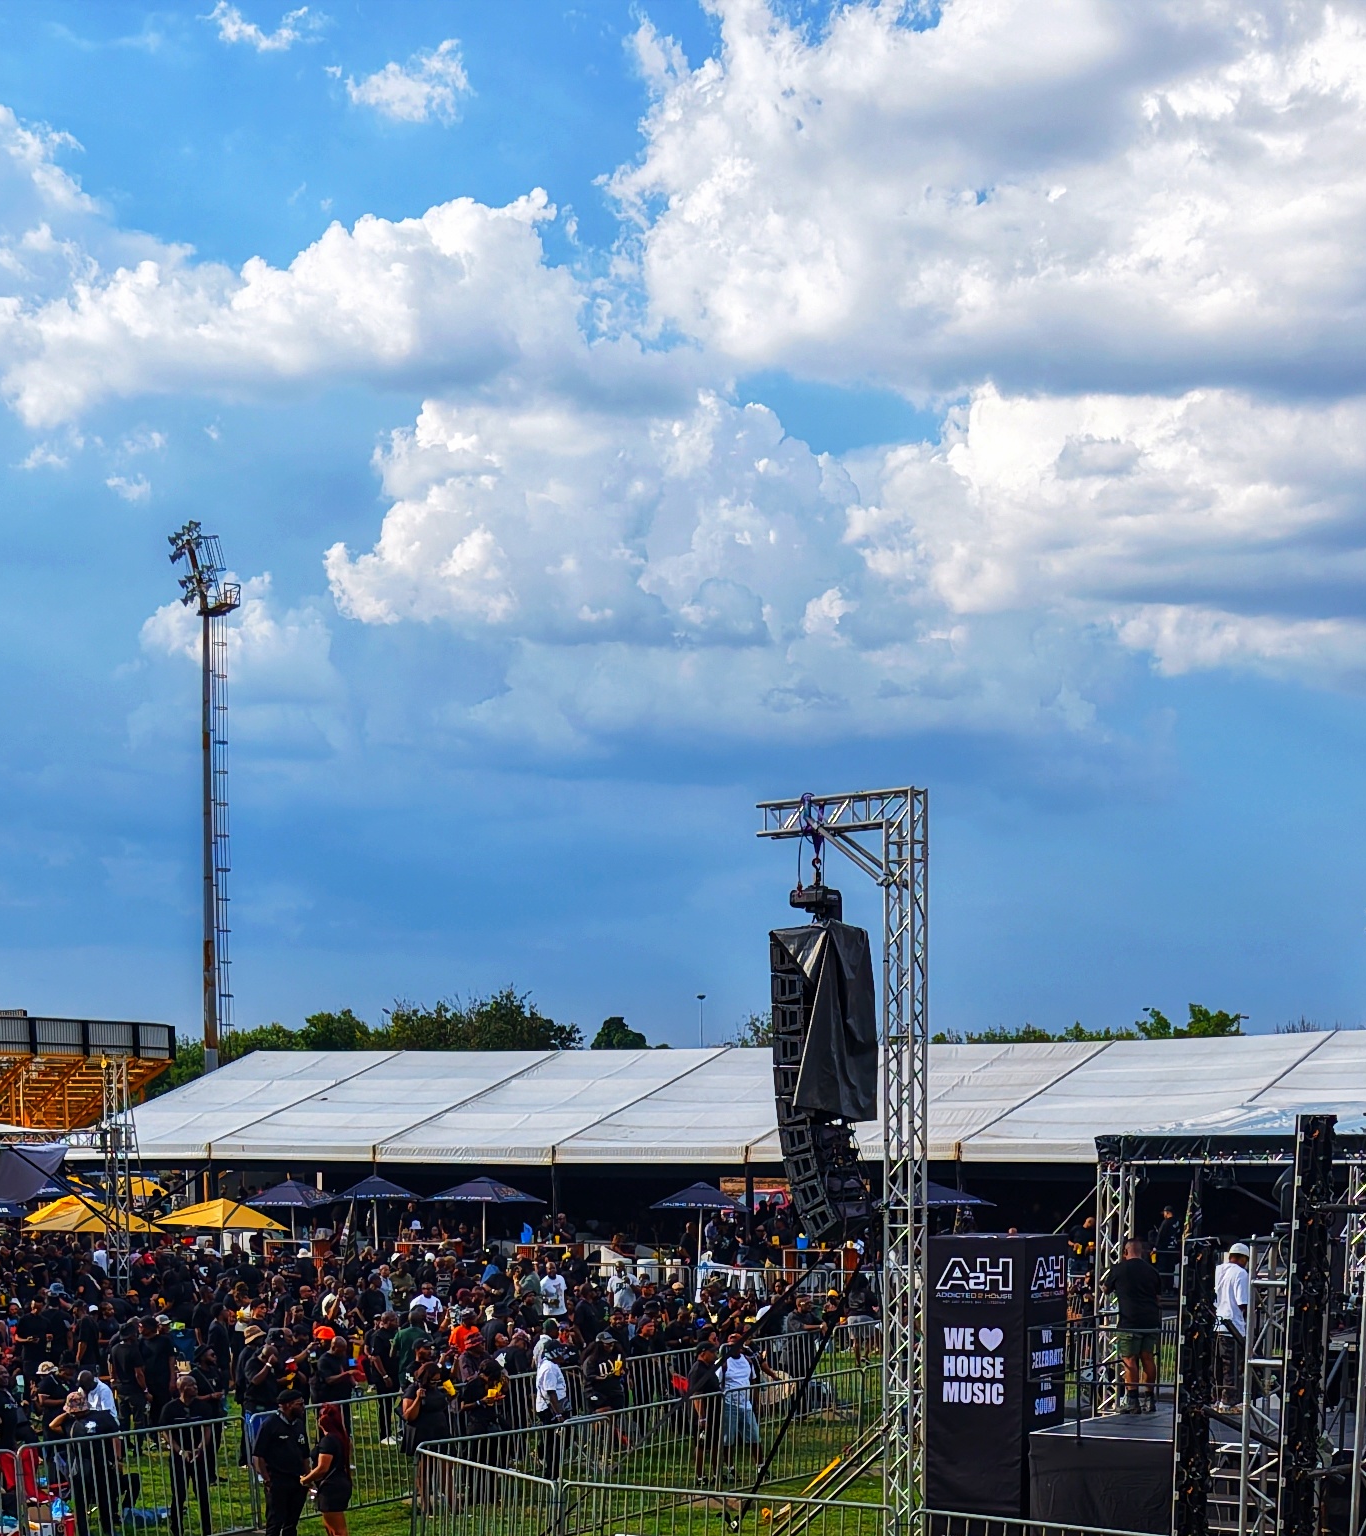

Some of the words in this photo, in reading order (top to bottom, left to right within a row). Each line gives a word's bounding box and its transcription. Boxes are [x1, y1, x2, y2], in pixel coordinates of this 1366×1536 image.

[935, 1257, 1013, 1291] A2H
[1030, 1254, 1065, 1291] A2H
[935, 1291, 977, 1299] ADDICTED
[984, 1292, 1013, 1300] HOUSE
[943, 1327, 975, 1351] WE
[1041, 1327, 1053, 1344] WE
[943, 1355, 1005, 1379] HOUSE
[1031, 1347, 1064, 1370] CELEBRATE
[942, 1381, 1005, 1405] MUSIC
[1034, 1395, 1057, 1416] SOUND
